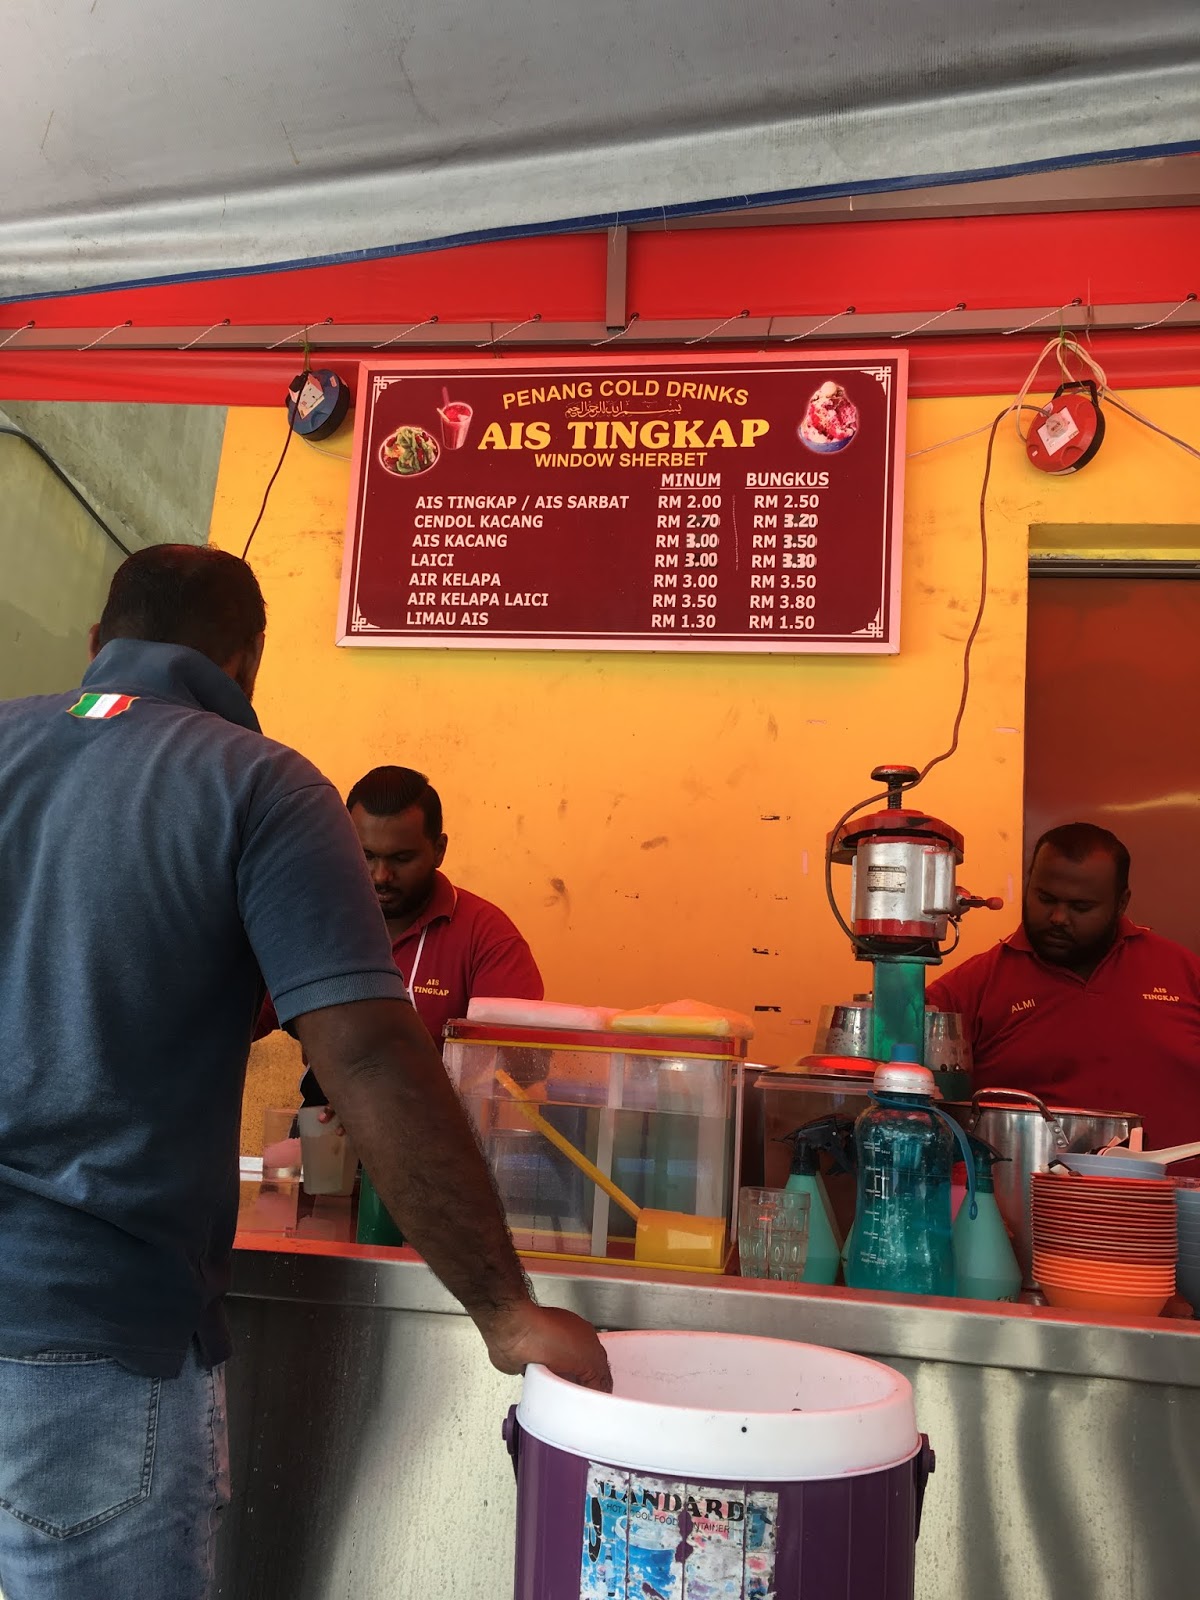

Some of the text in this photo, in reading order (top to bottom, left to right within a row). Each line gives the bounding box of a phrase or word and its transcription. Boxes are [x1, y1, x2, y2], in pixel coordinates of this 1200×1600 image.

[503, 380, 748, 409] PENANG COLD DRINKS
[478, 419, 769, 449] AIS TINGKAP
[535, 453, 707, 467] WINDOW SHERBET
[662, 473, 720, 487] MINUM
[747, 472, 829, 486] BUNGKUS
[416, 496, 629, 511] AIS TINGKAP / AIS SARBAT
[658, 495, 721, 508] RM 2.00
[755, 495, 819, 508] RM 2.50
[415, 515, 543, 528] CENDOL KACANG
[657, 514, 720, 528] RM 2.70
[754, 514, 818, 528] RM 3.20
[412, 534, 507, 547] AIS KACANG
[656, 533, 719, 548] RM 3.00
[753, 534, 817, 548] RM 3.50
[412, 554, 454, 566] LAICI
[655, 553, 717, 567] RM 3.00
[752, 553, 816, 568] RM 3.30
[409, 573, 500, 586] AIR KELAPA
[654, 574, 717, 588] RM 3.00
[751, 575, 816, 588] RM 3.50
[407, 593, 548, 606] AIR KELAPA LAICI
[653, 594, 716, 608] RM 3.50
[750, 595, 815, 609] RM 3.80
[407, 612, 488, 625] LIMAU AIS
[652, 614, 715, 628] RM 1.30
[749, 615, 814, 629] RM 1.50
[414, 986, 449, 996] TINGKAP
[1142, 993, 1180, 1002] TINGKAP
[1011, 999, 1036, 1013] ALMI
[594, 1479, 745, 1522] ANDARD
[606, 1503, 622, 1513] HOT
